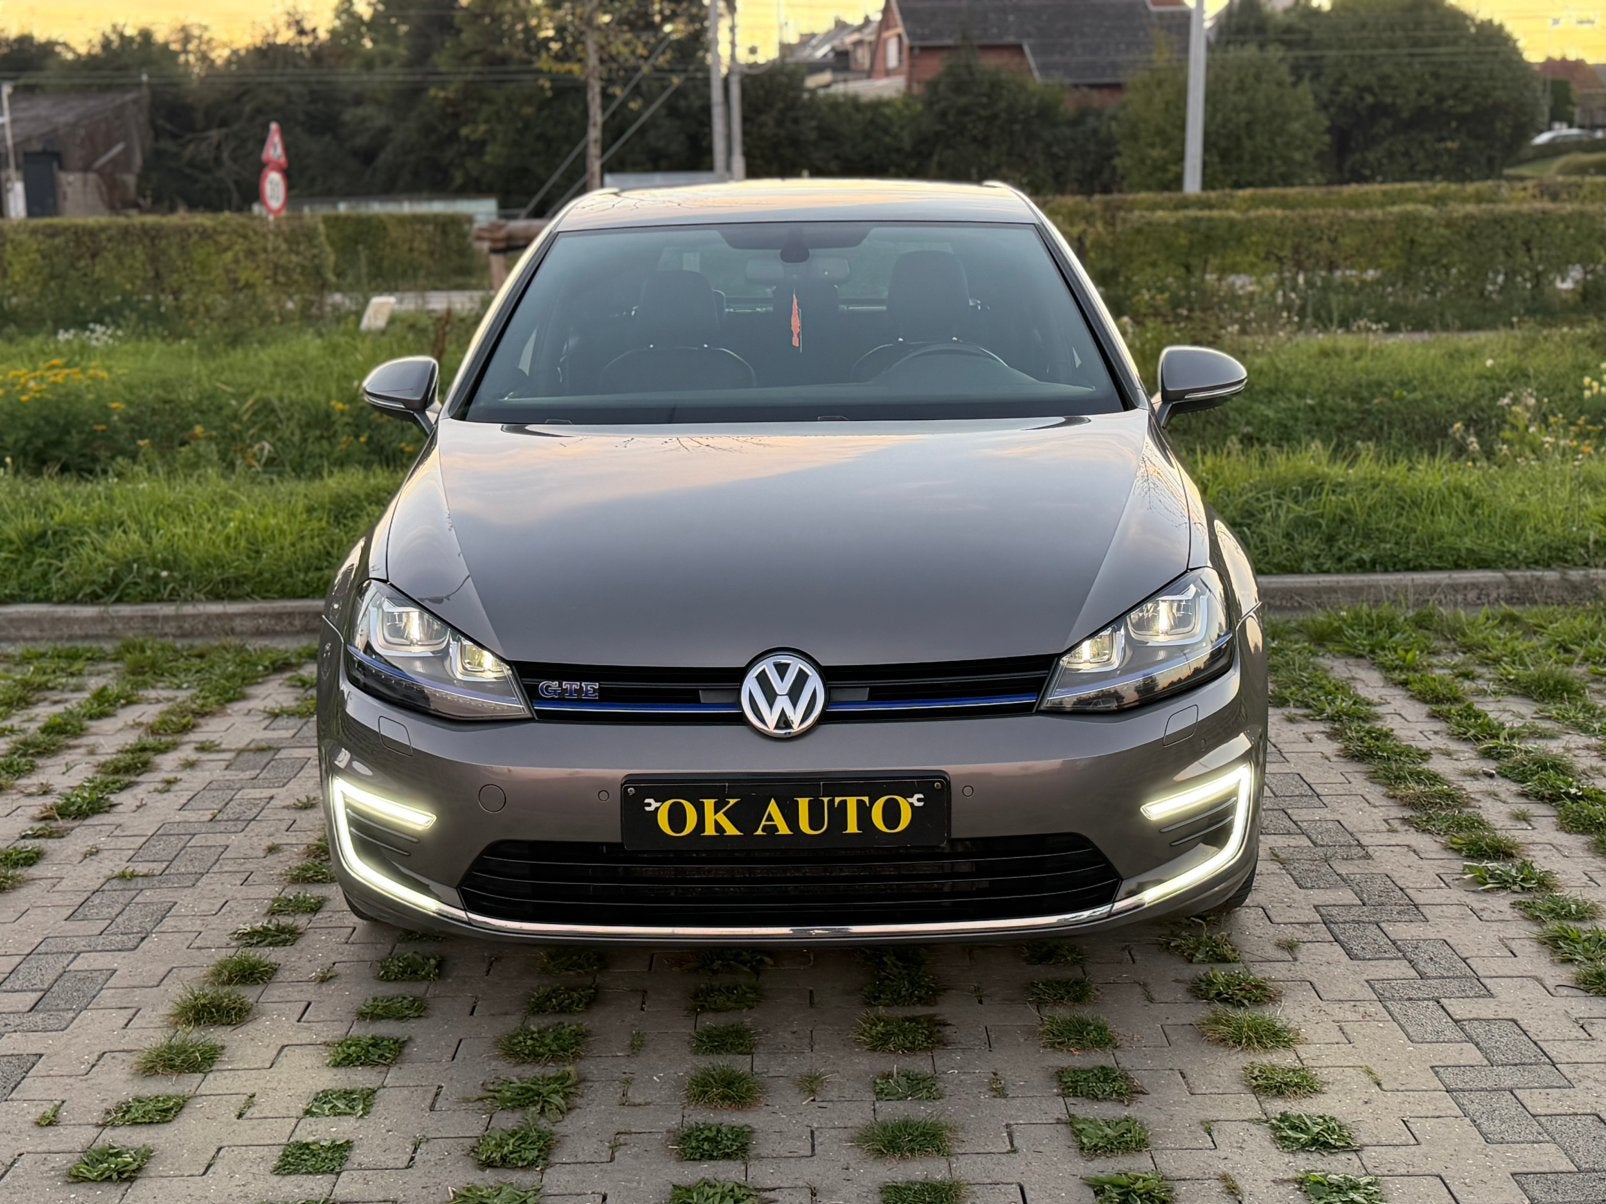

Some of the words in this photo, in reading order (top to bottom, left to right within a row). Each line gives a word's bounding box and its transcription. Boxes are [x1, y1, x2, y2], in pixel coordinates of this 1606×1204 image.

[538, 680, 600, 700] GTE
[743, 656, 824, 736] VW
[657, 799, 743, 836] OK
[753, 795, 912, 835] AUTO
